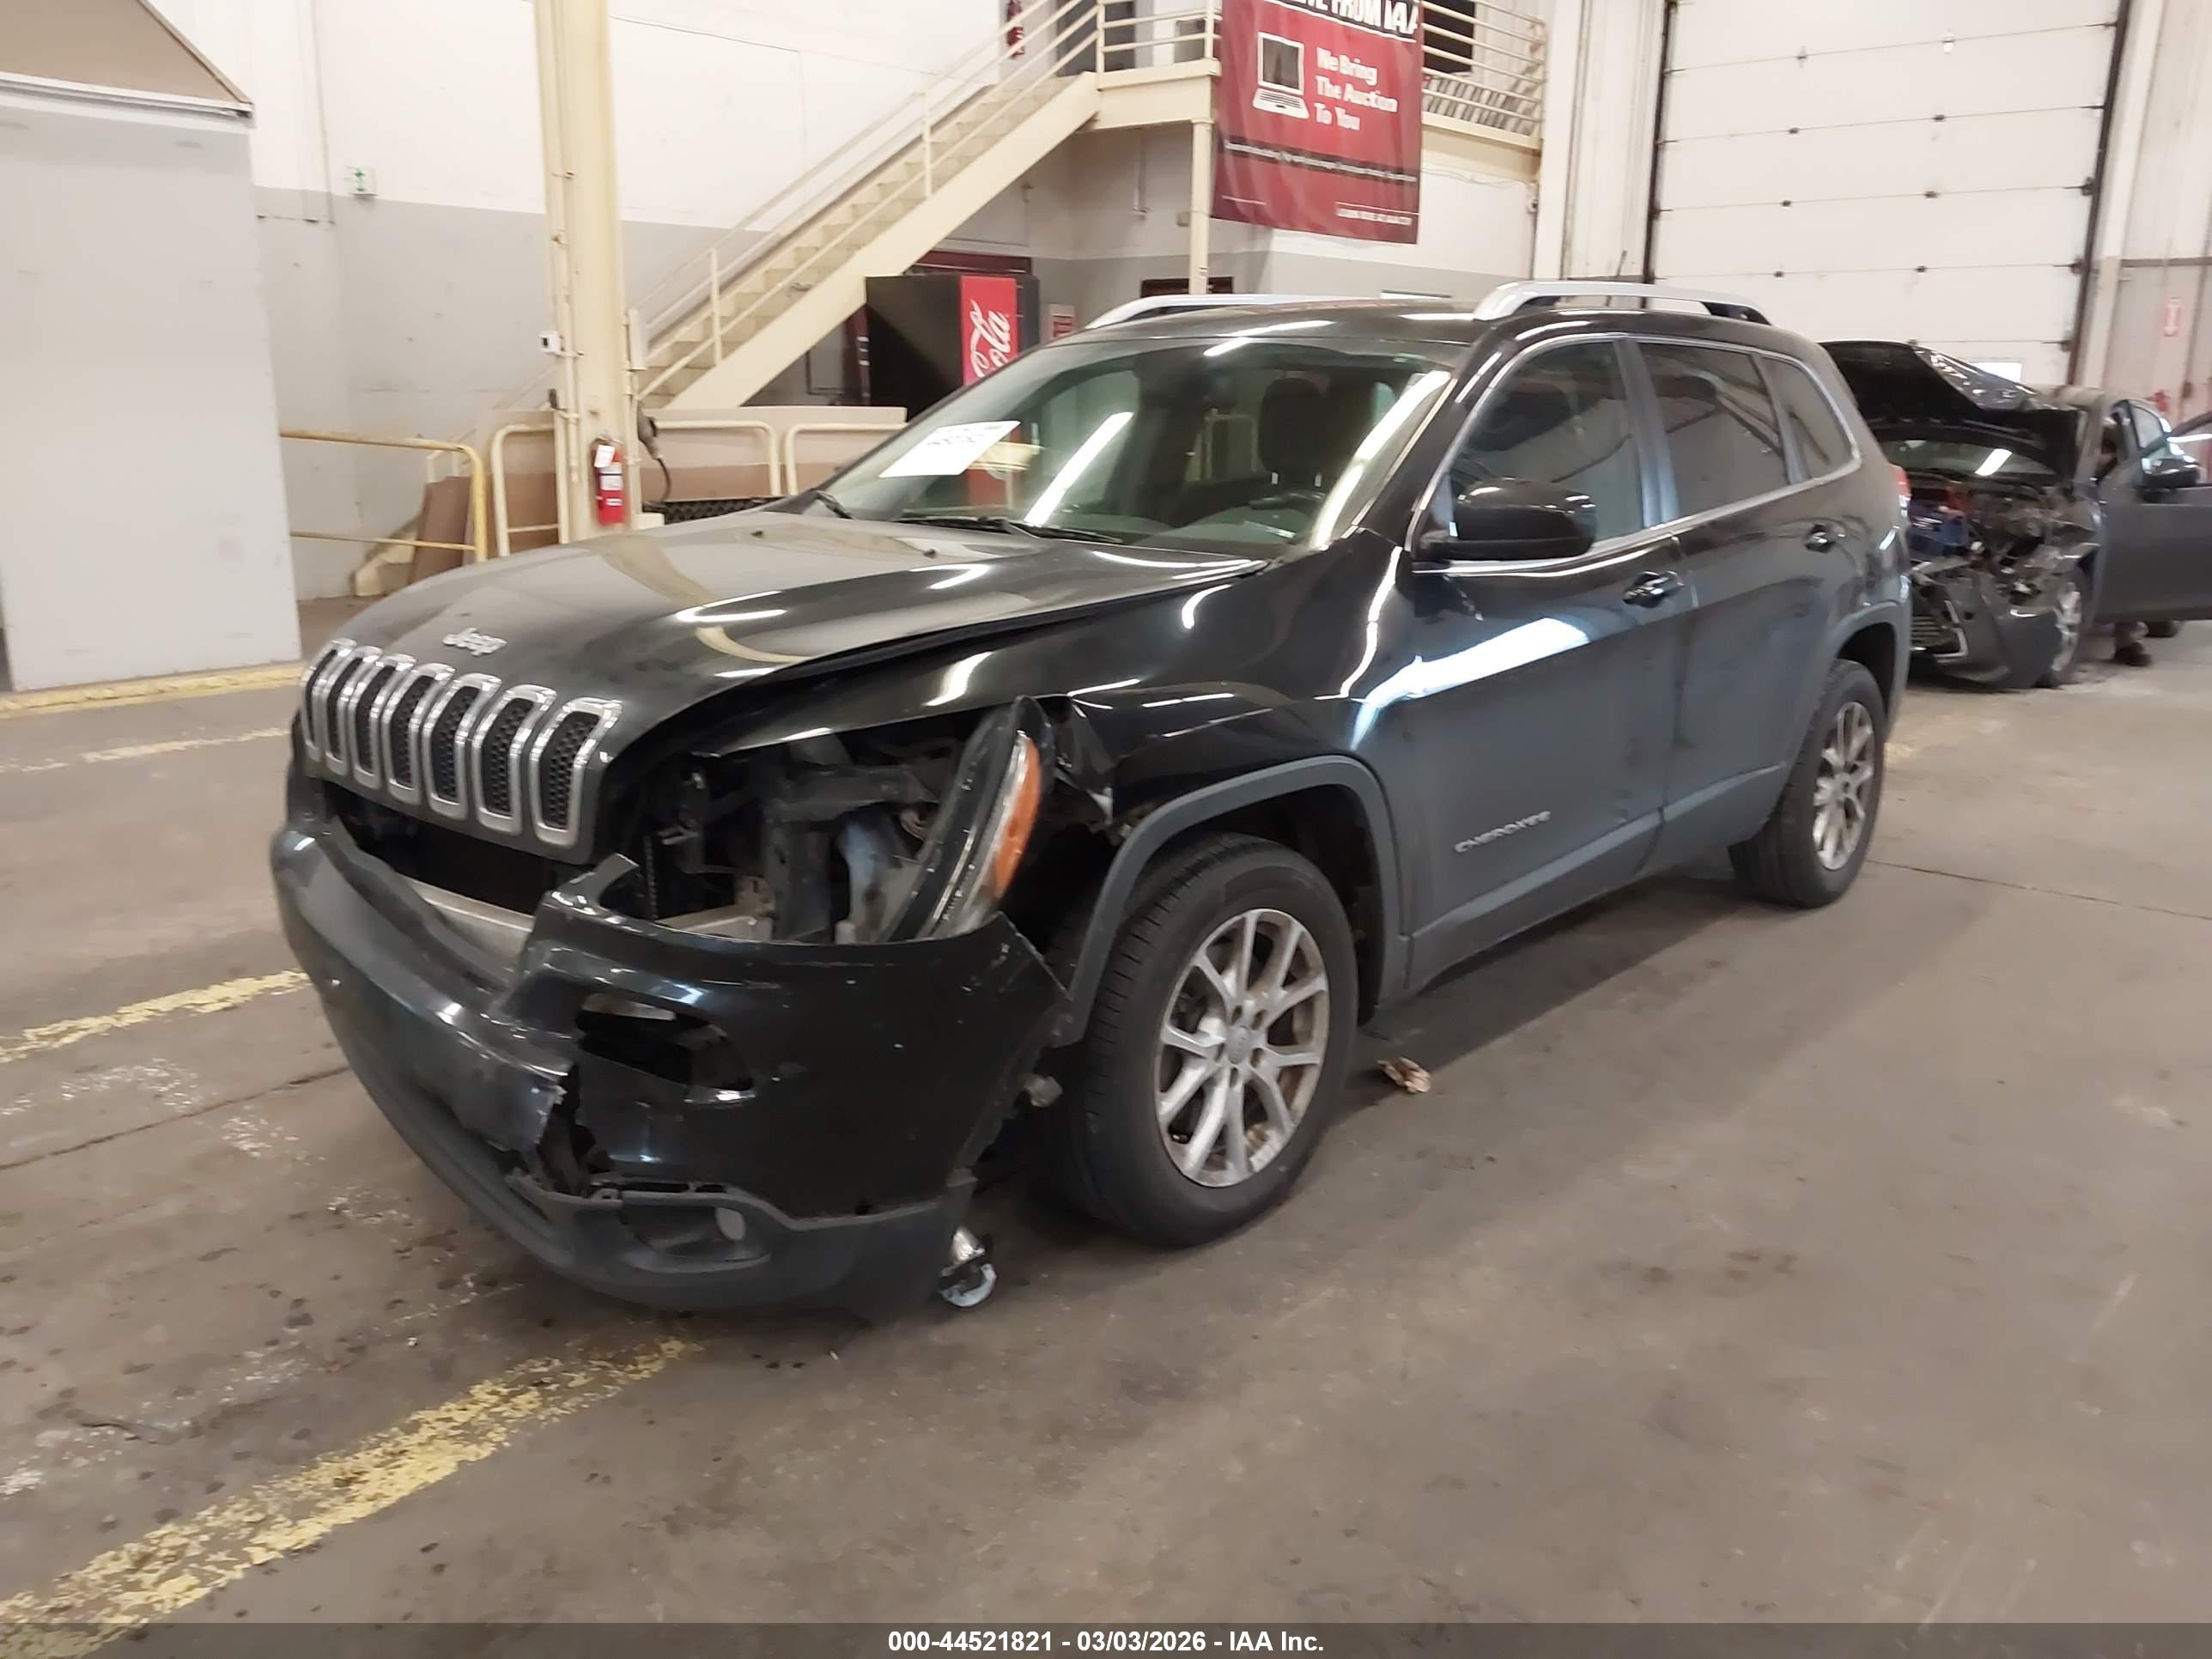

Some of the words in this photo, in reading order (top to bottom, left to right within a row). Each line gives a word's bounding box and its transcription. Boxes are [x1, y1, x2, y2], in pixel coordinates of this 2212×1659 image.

[1316, 46, 1339, 71] We
[1339, 54, 1377, 86] Bring
[1316, 75, 1342, 100] The
[1343, 82, 1398, 112] Auction
[1314, 102, 1332, 125] To
[1334, 106, 1360, 131] You
[441, 627, 508, 658] Jeep
